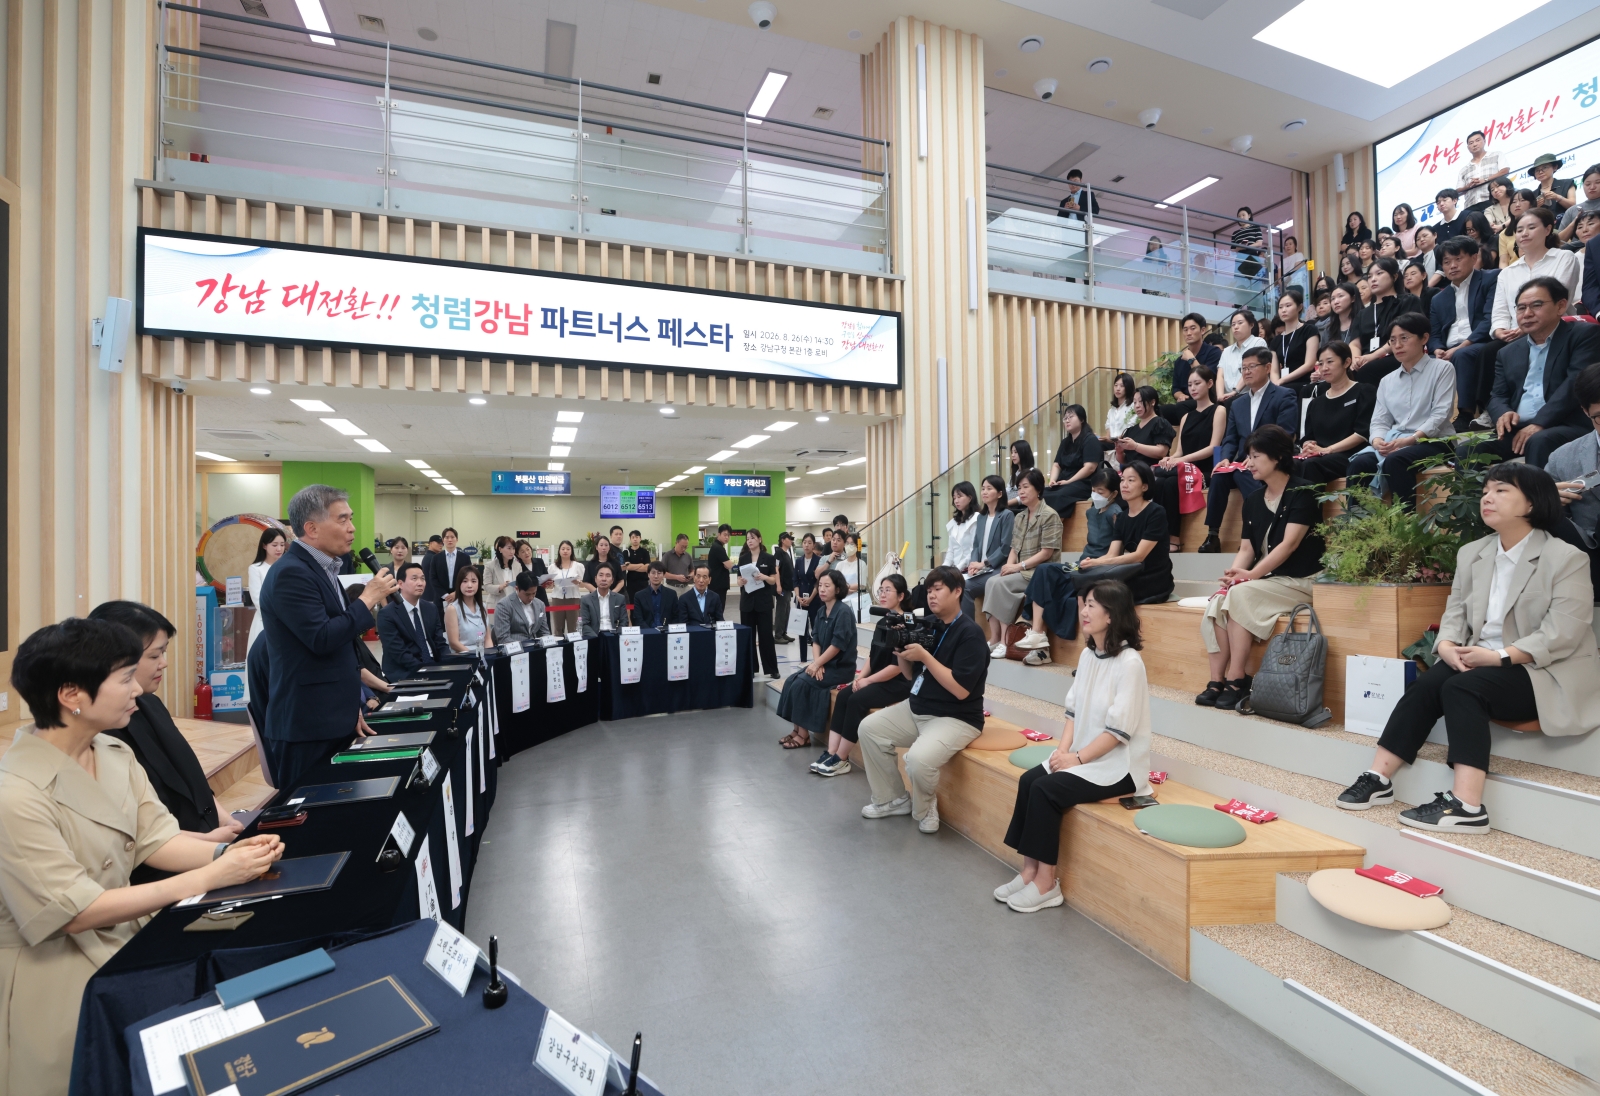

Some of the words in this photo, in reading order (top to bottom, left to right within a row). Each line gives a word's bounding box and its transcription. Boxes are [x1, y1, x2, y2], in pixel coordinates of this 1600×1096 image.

[1418, 138, 1463, 176] 강남
[1572, 76, 1598, 109] 청
[195, 272, 271, 315] 강남
[281, 280, 401, 321] 대전환!!
[411, 293, 533, 336] 청렴강남
[540, 306, 651, 342] 파트너스
[657, 317, 733, 353] 페스타
[743, 329, 757, 339] 일시
[760, 331, 781, 341] 2026.
[783, 333, 790, 342] 8.
[791, 334, 813, 344] 26(수)
[815, 336, 834, 346] 14:30
[743, 342, 758, 352] 장소
[815, 348, 828, 358] 로비
[514, 474, 536, 484] 부동산
[724, 478, 742, 487] 부동산
[548, 1037, 596, 1086] 강남구상공회
